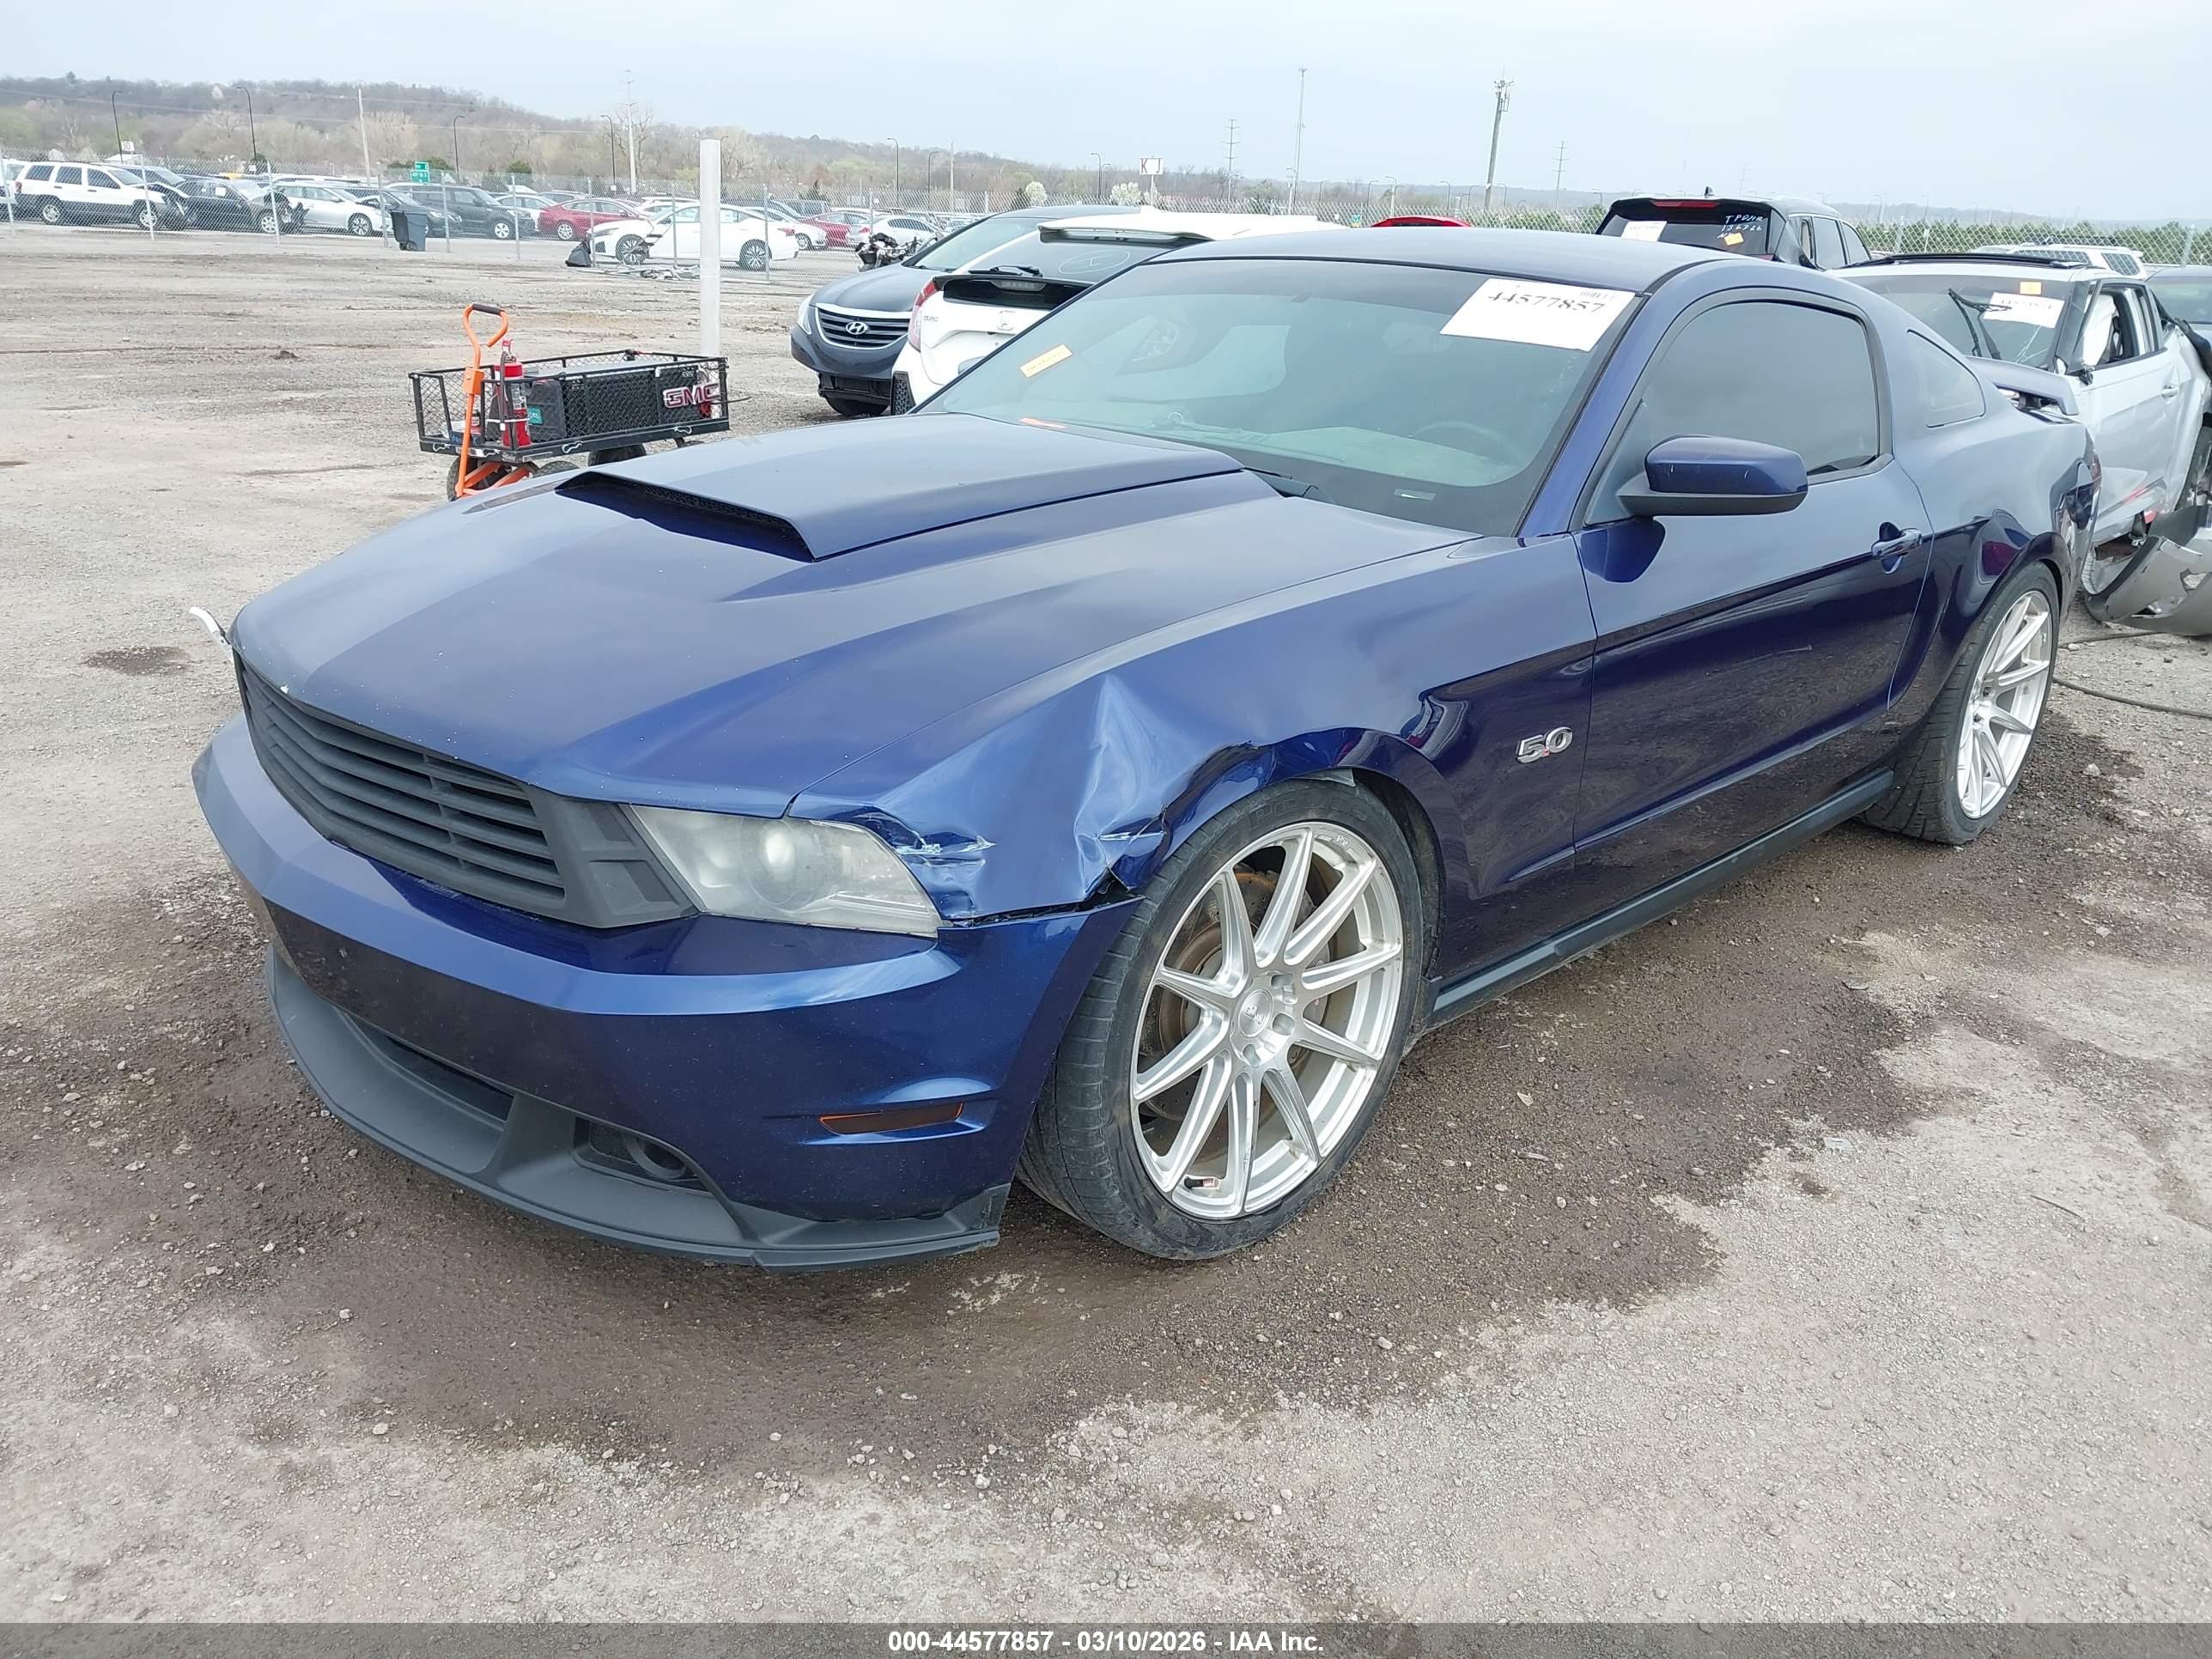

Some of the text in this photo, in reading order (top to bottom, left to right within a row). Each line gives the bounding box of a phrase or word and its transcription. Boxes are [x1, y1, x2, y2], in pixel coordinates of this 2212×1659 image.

[1141, 158, 1161, 173] K J
[1488, 291, 1606, 313] 44577857
[662, 383, 720, 409] GMC
[1516, 726, 1573, 763] 5.0
